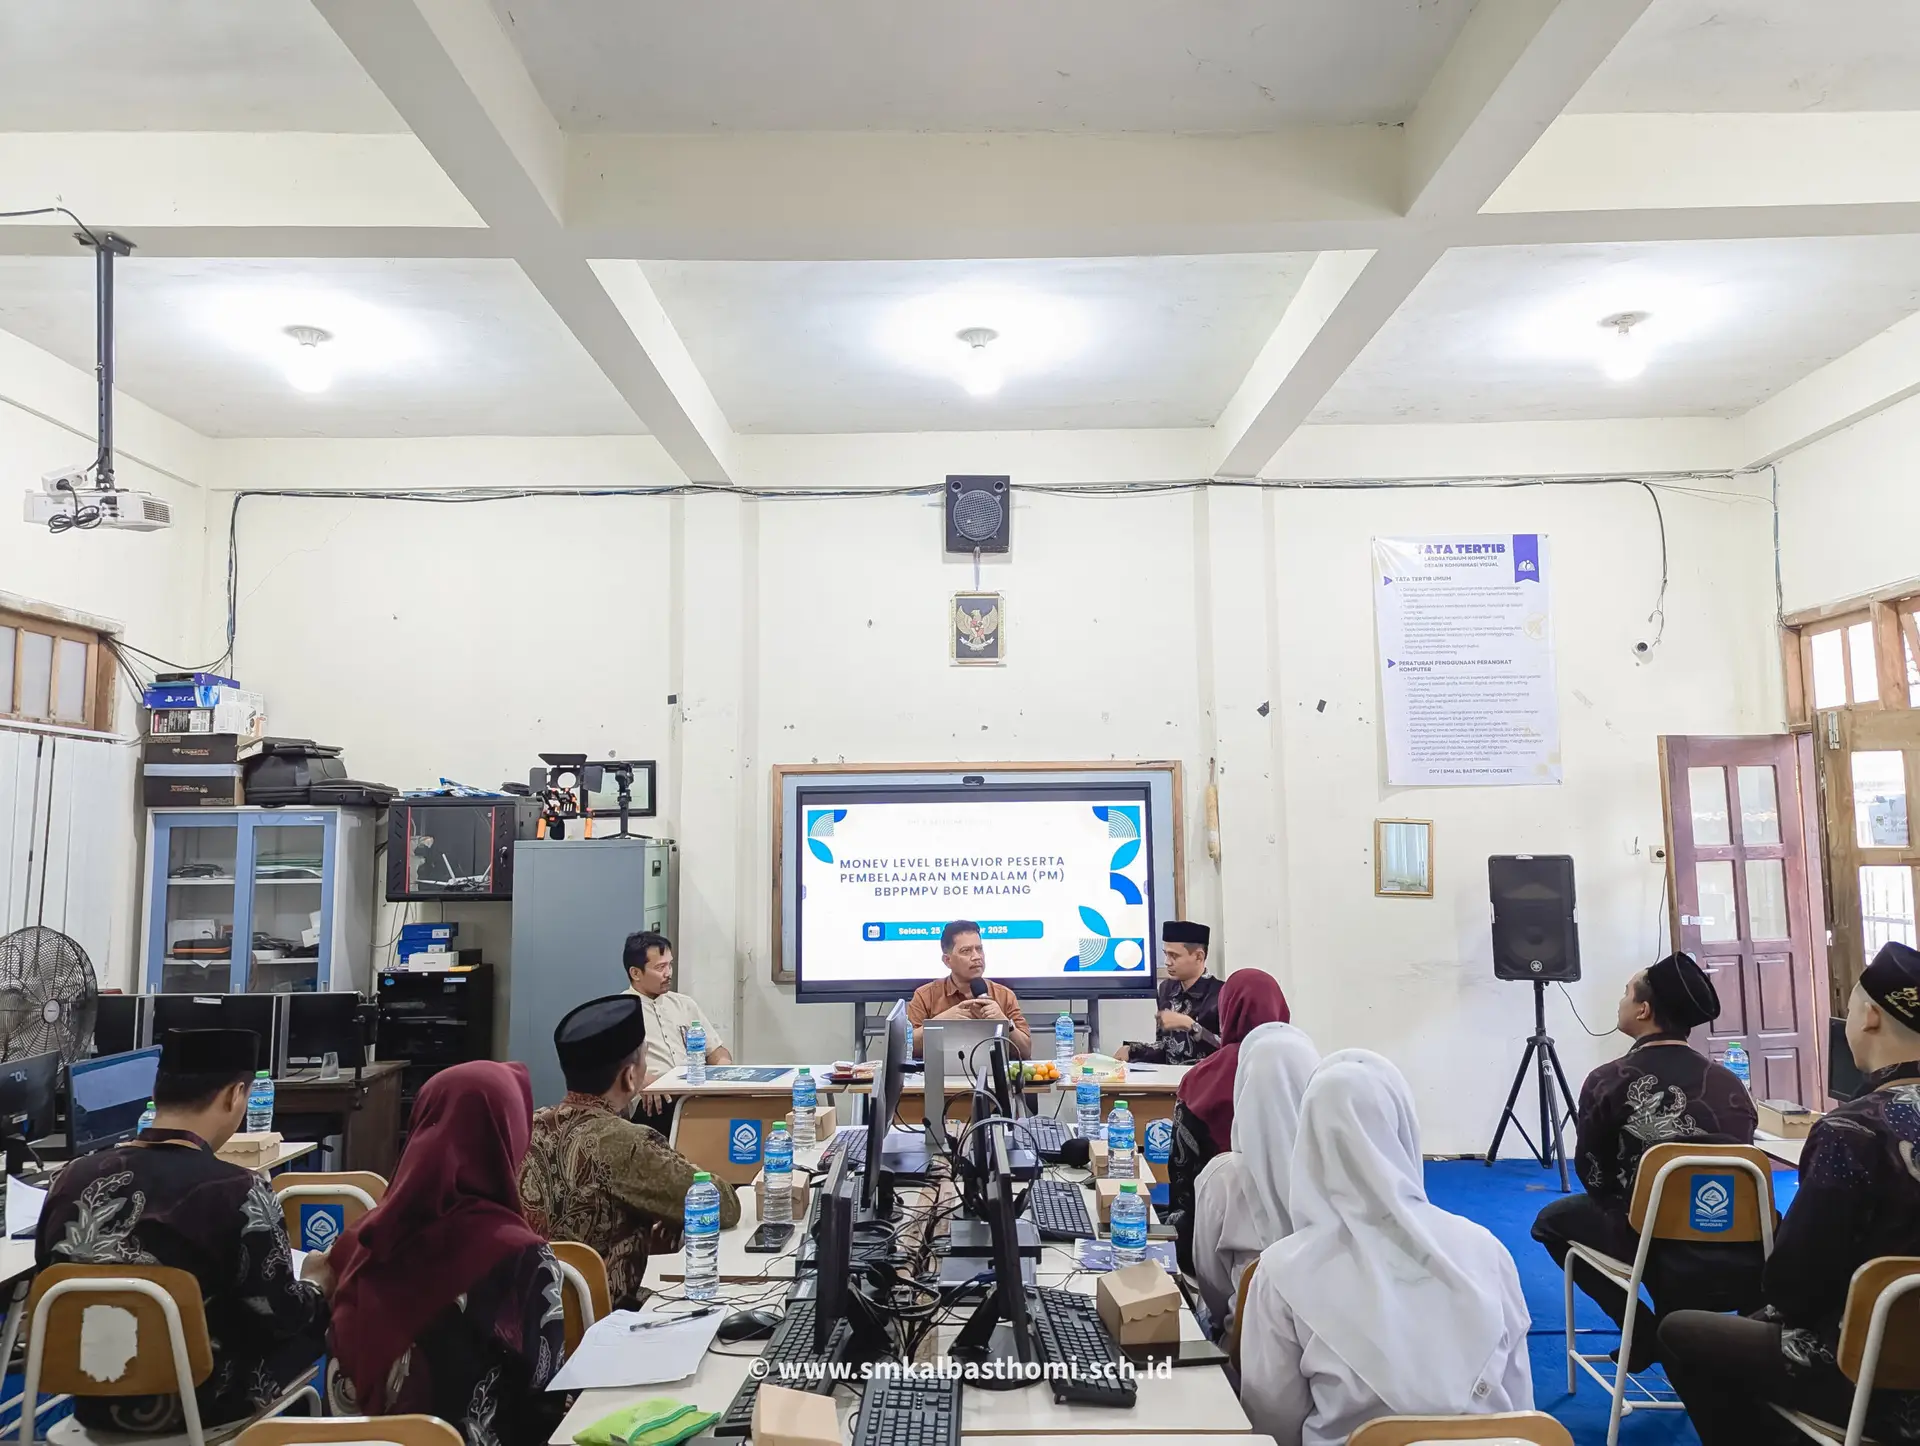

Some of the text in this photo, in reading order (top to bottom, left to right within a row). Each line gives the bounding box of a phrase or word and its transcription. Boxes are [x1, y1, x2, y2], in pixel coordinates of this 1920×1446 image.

[1455, 543, 1506, 554] TERTIB
[840, 856, 1065, 869] MONEV LEVEL BEHAVIOR PESERTA
[840, 868, 1065, 883] PEMBELAJARAN MENDALAM (PM)
[874, 884, 1031, 897] BBPPMPV BOE MALANG
[898, 926, 929, 936] Selasa,
[930, 926, 941, 935] 25
[987, 925, 1009, 934] 2025
